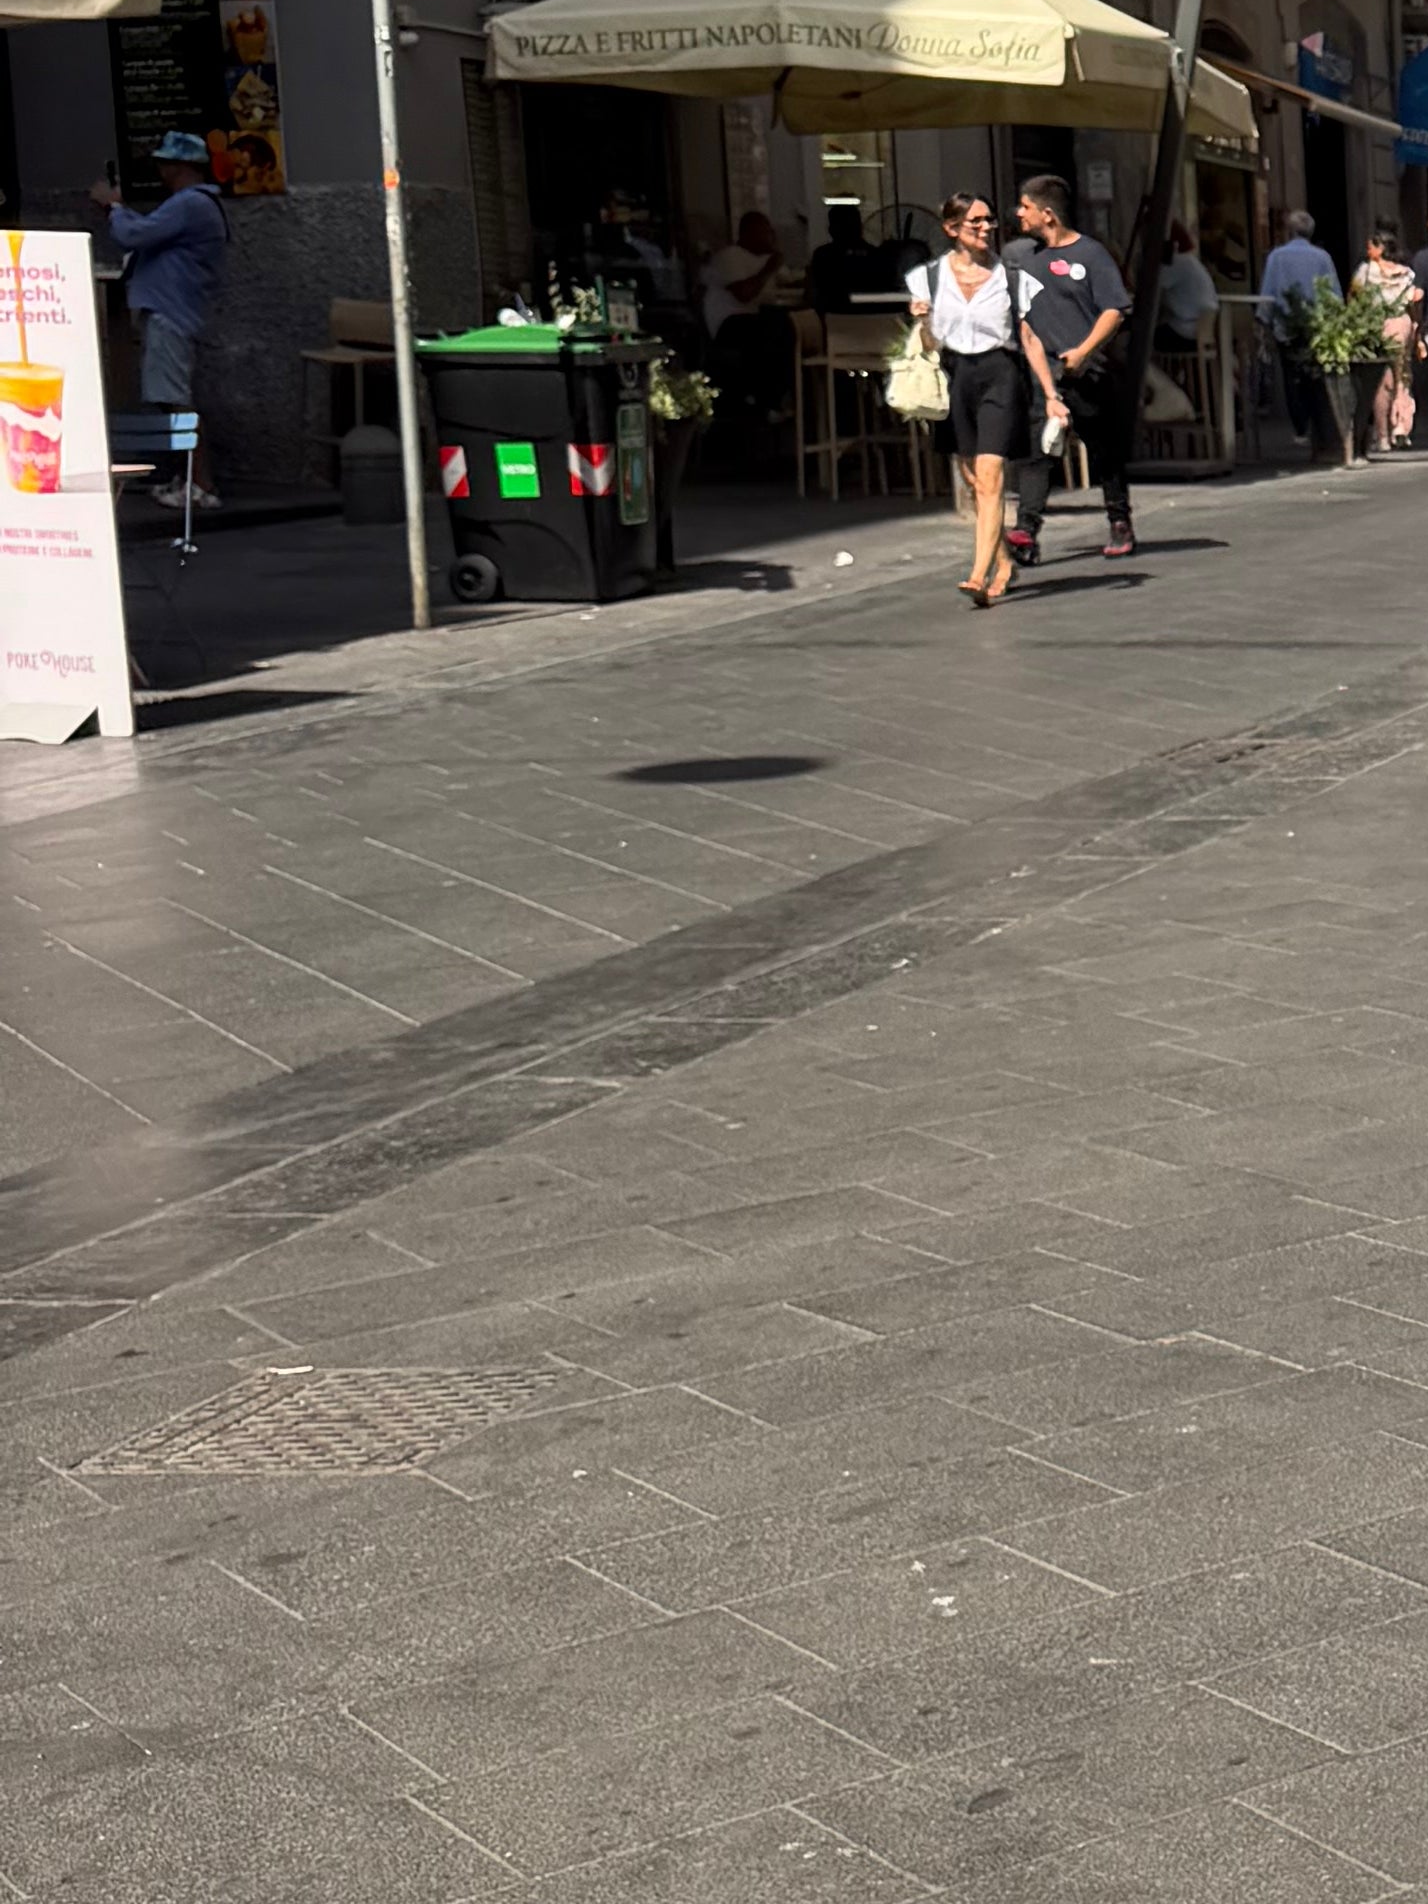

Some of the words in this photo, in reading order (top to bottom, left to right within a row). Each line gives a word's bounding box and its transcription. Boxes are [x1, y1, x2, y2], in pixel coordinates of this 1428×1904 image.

[515, 33, 589, 57] PIZZA
[596, 32, 611, 53] E
[617, 28, 698, 52] FRITTI
[704, 22, 863, 49] NAPOLETANI
[867, 19, 966, 58] Donna
[968, 28, 1041, 68] Sofia
